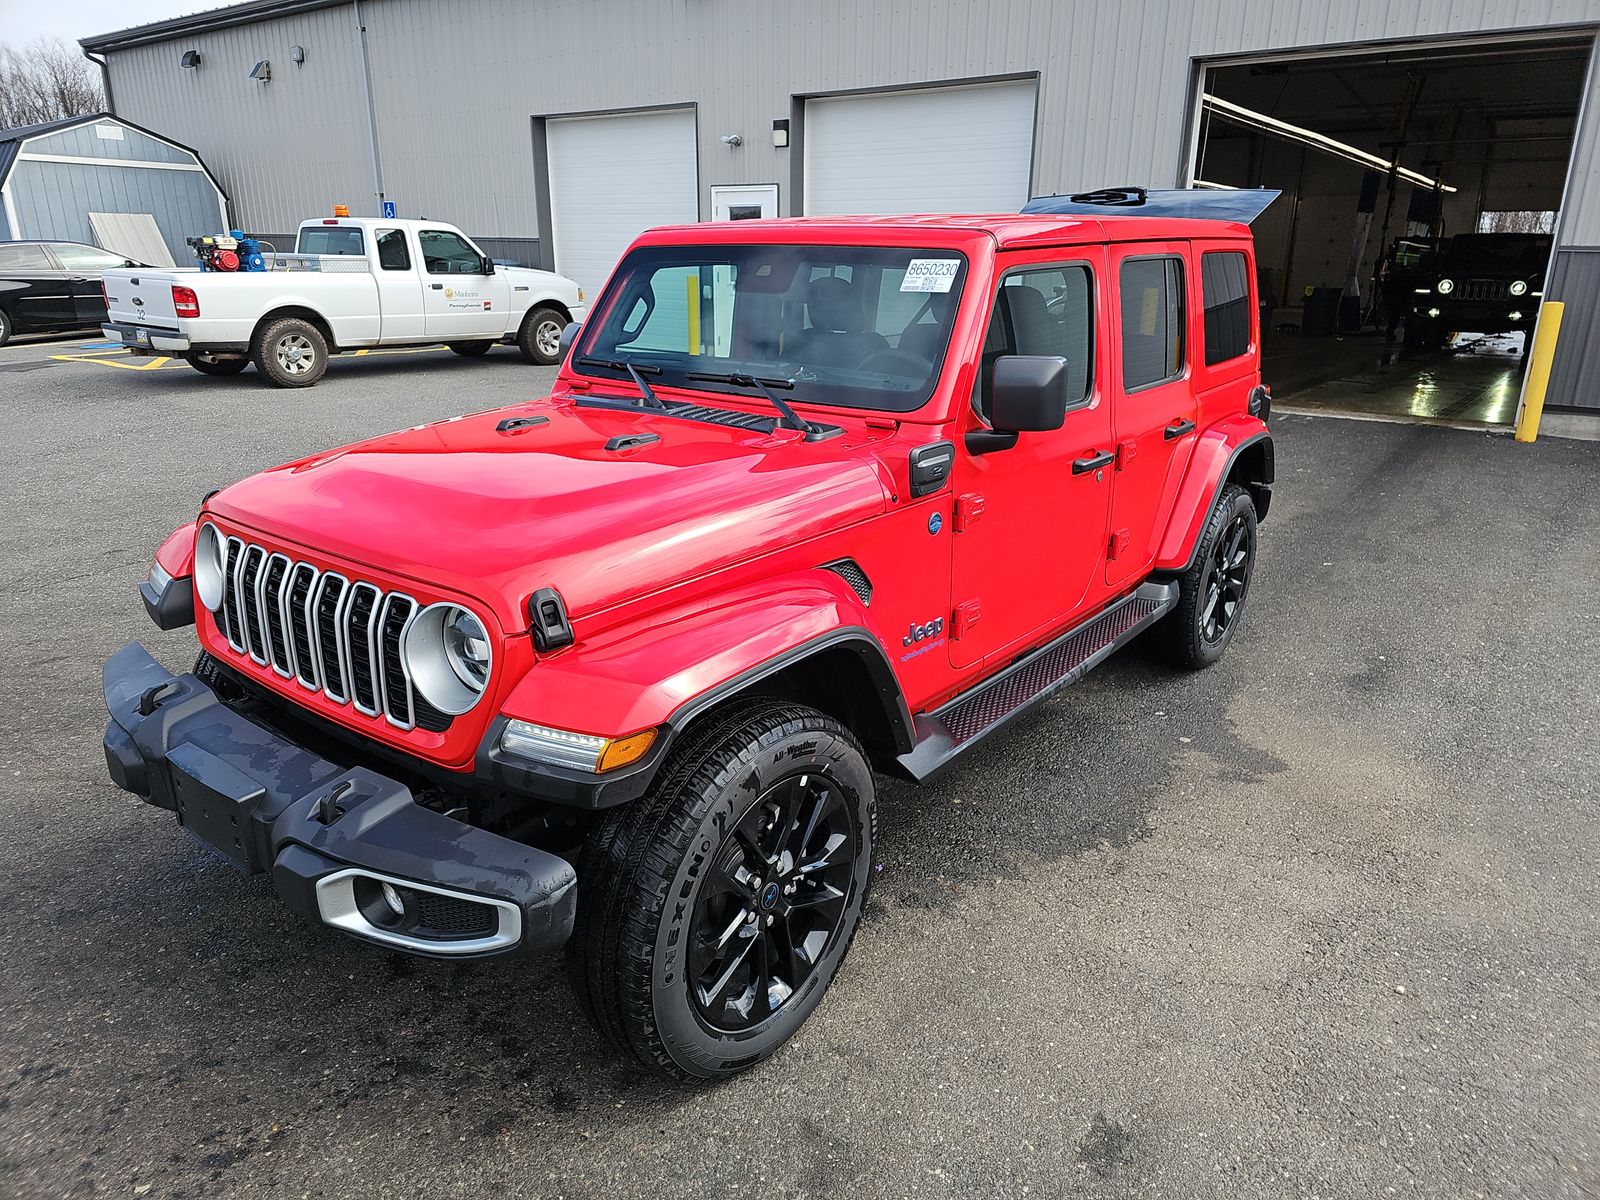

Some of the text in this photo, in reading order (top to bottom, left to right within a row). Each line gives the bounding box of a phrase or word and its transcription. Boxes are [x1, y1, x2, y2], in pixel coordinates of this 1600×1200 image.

[909, 263, 958, 276] 8650230
[136, 309, 145, 320] 32
[903, 616, 944, 647] Jeep
[773, 740, 818, 765] All-Weather
[664, 852, 706, 972] NEXEN
